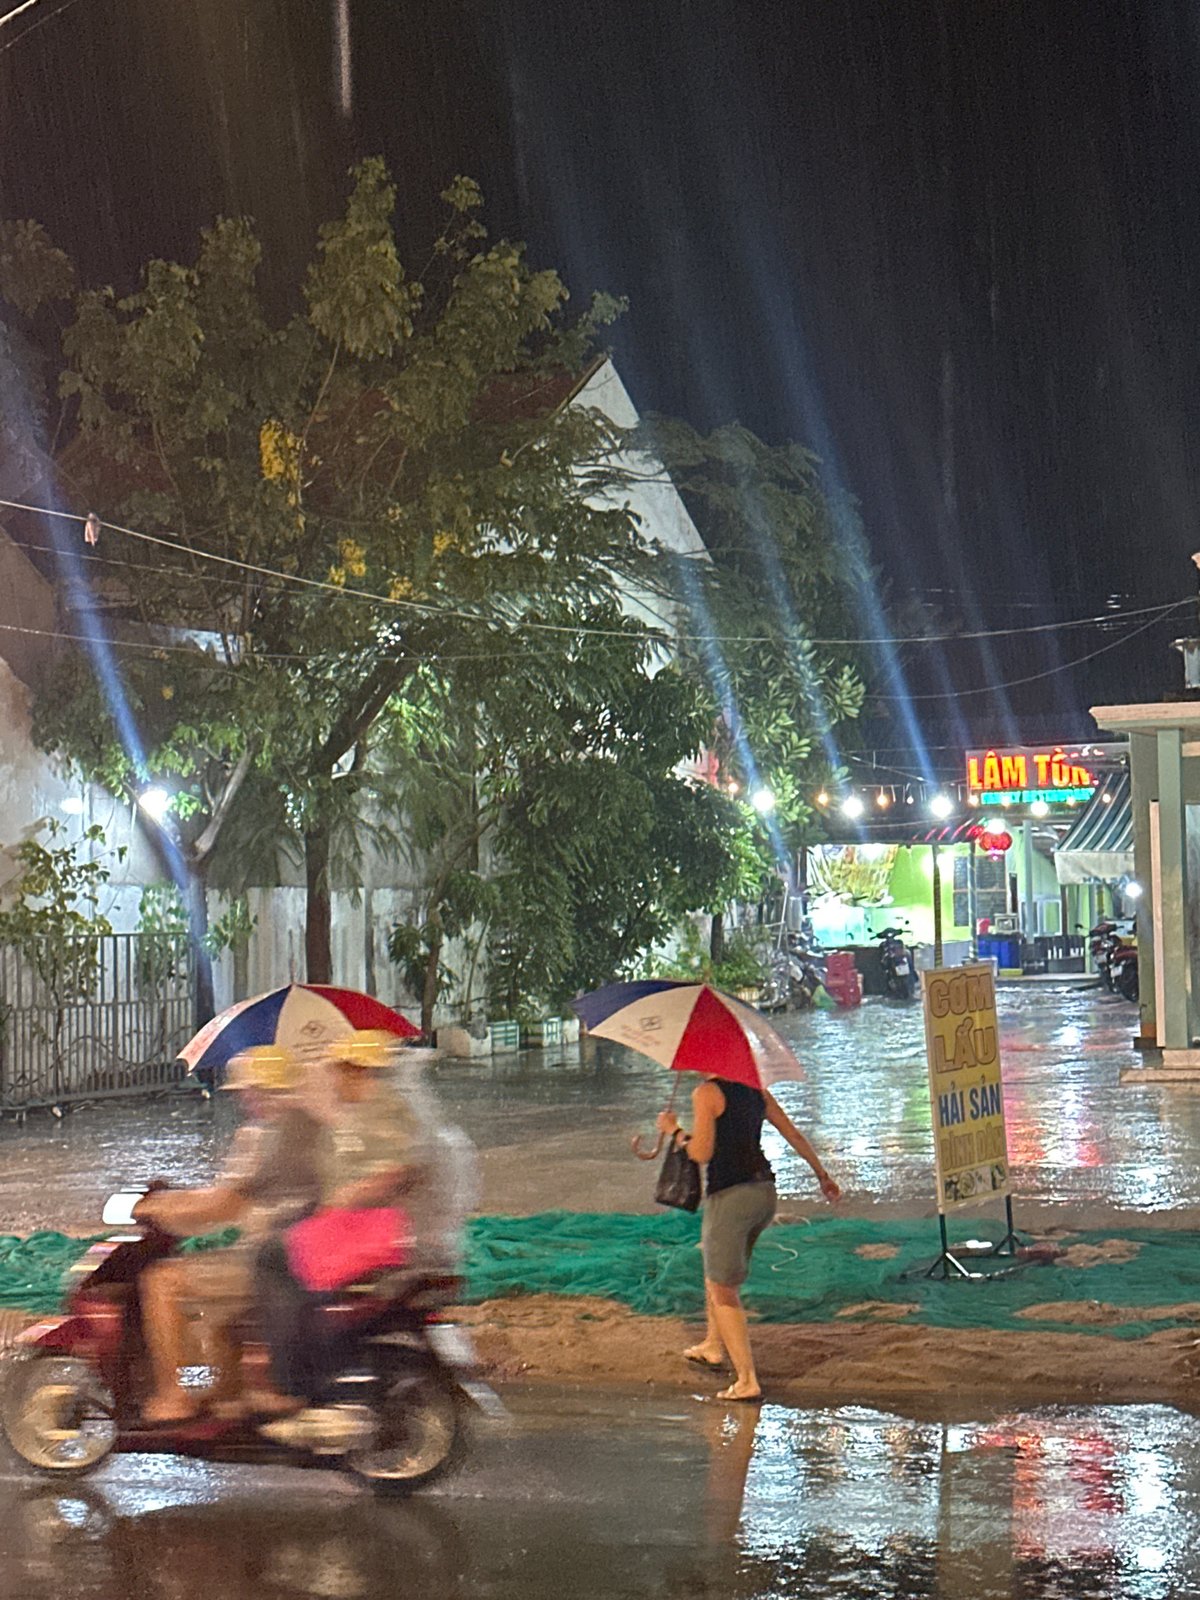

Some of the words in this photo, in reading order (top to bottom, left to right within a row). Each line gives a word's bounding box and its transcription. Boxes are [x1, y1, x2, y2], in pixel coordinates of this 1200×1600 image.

[968, 750, 1027, 789] LÂM
[929, 973, 994, 1018] CƠM
[938, 1081, 965, 1127] HẢI
[969, 1074, 1000, 1120] SẢN
